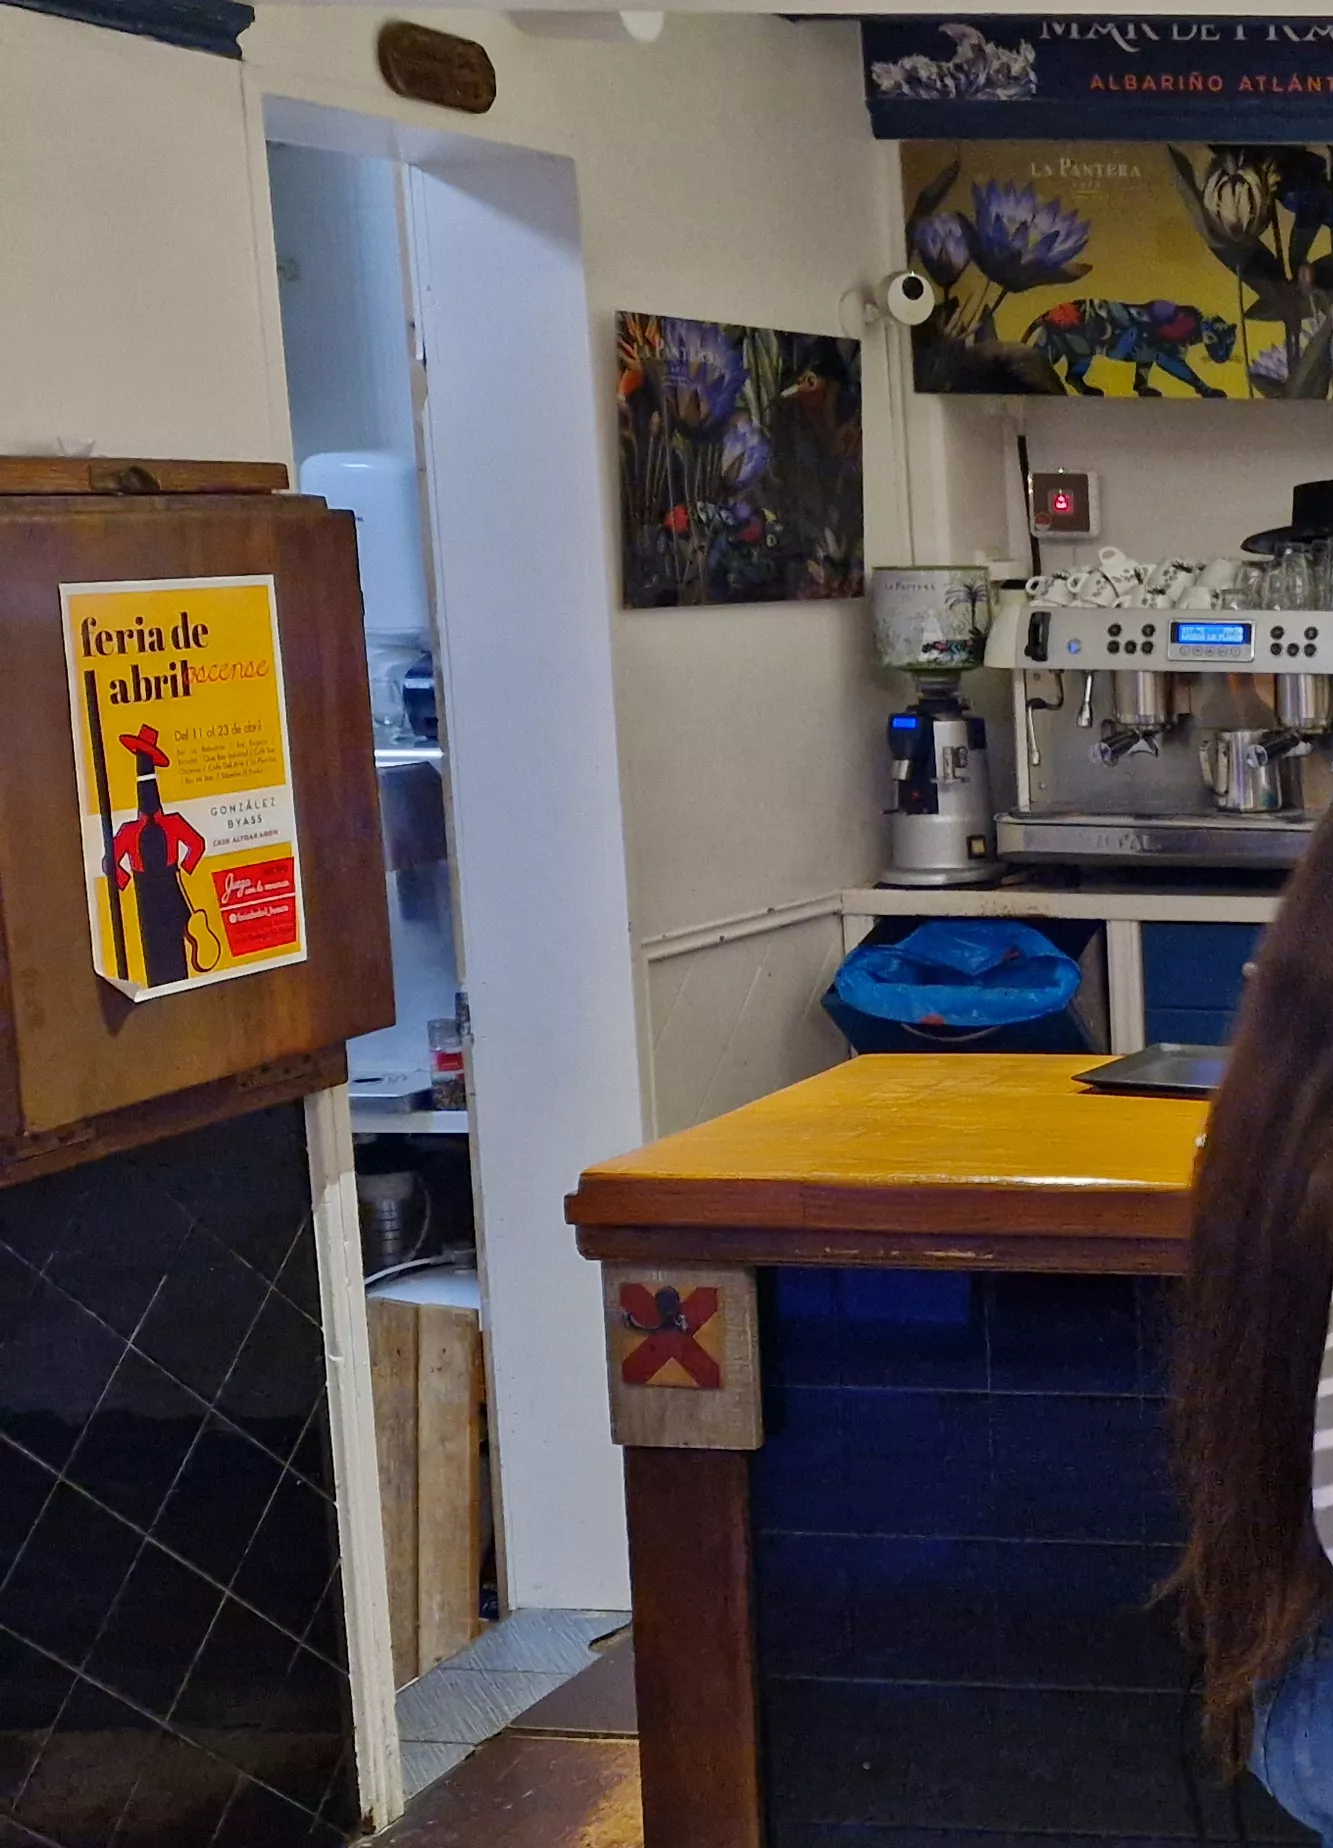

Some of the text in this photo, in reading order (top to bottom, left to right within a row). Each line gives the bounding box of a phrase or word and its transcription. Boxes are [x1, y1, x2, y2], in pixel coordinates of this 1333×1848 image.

[1089, 71, 1224, 93] ALBARIÑO
[1030, 161, 1053, 177] LA
[80, 611, 210, 659] feria de
[109, 658, 270, 706] abril oscense
[173, 728, 189, 742] Del
[192, 727, 203, 739] 11
[217, 723, 230, 737] 23
[227, 813, 264, 829] BYASS
